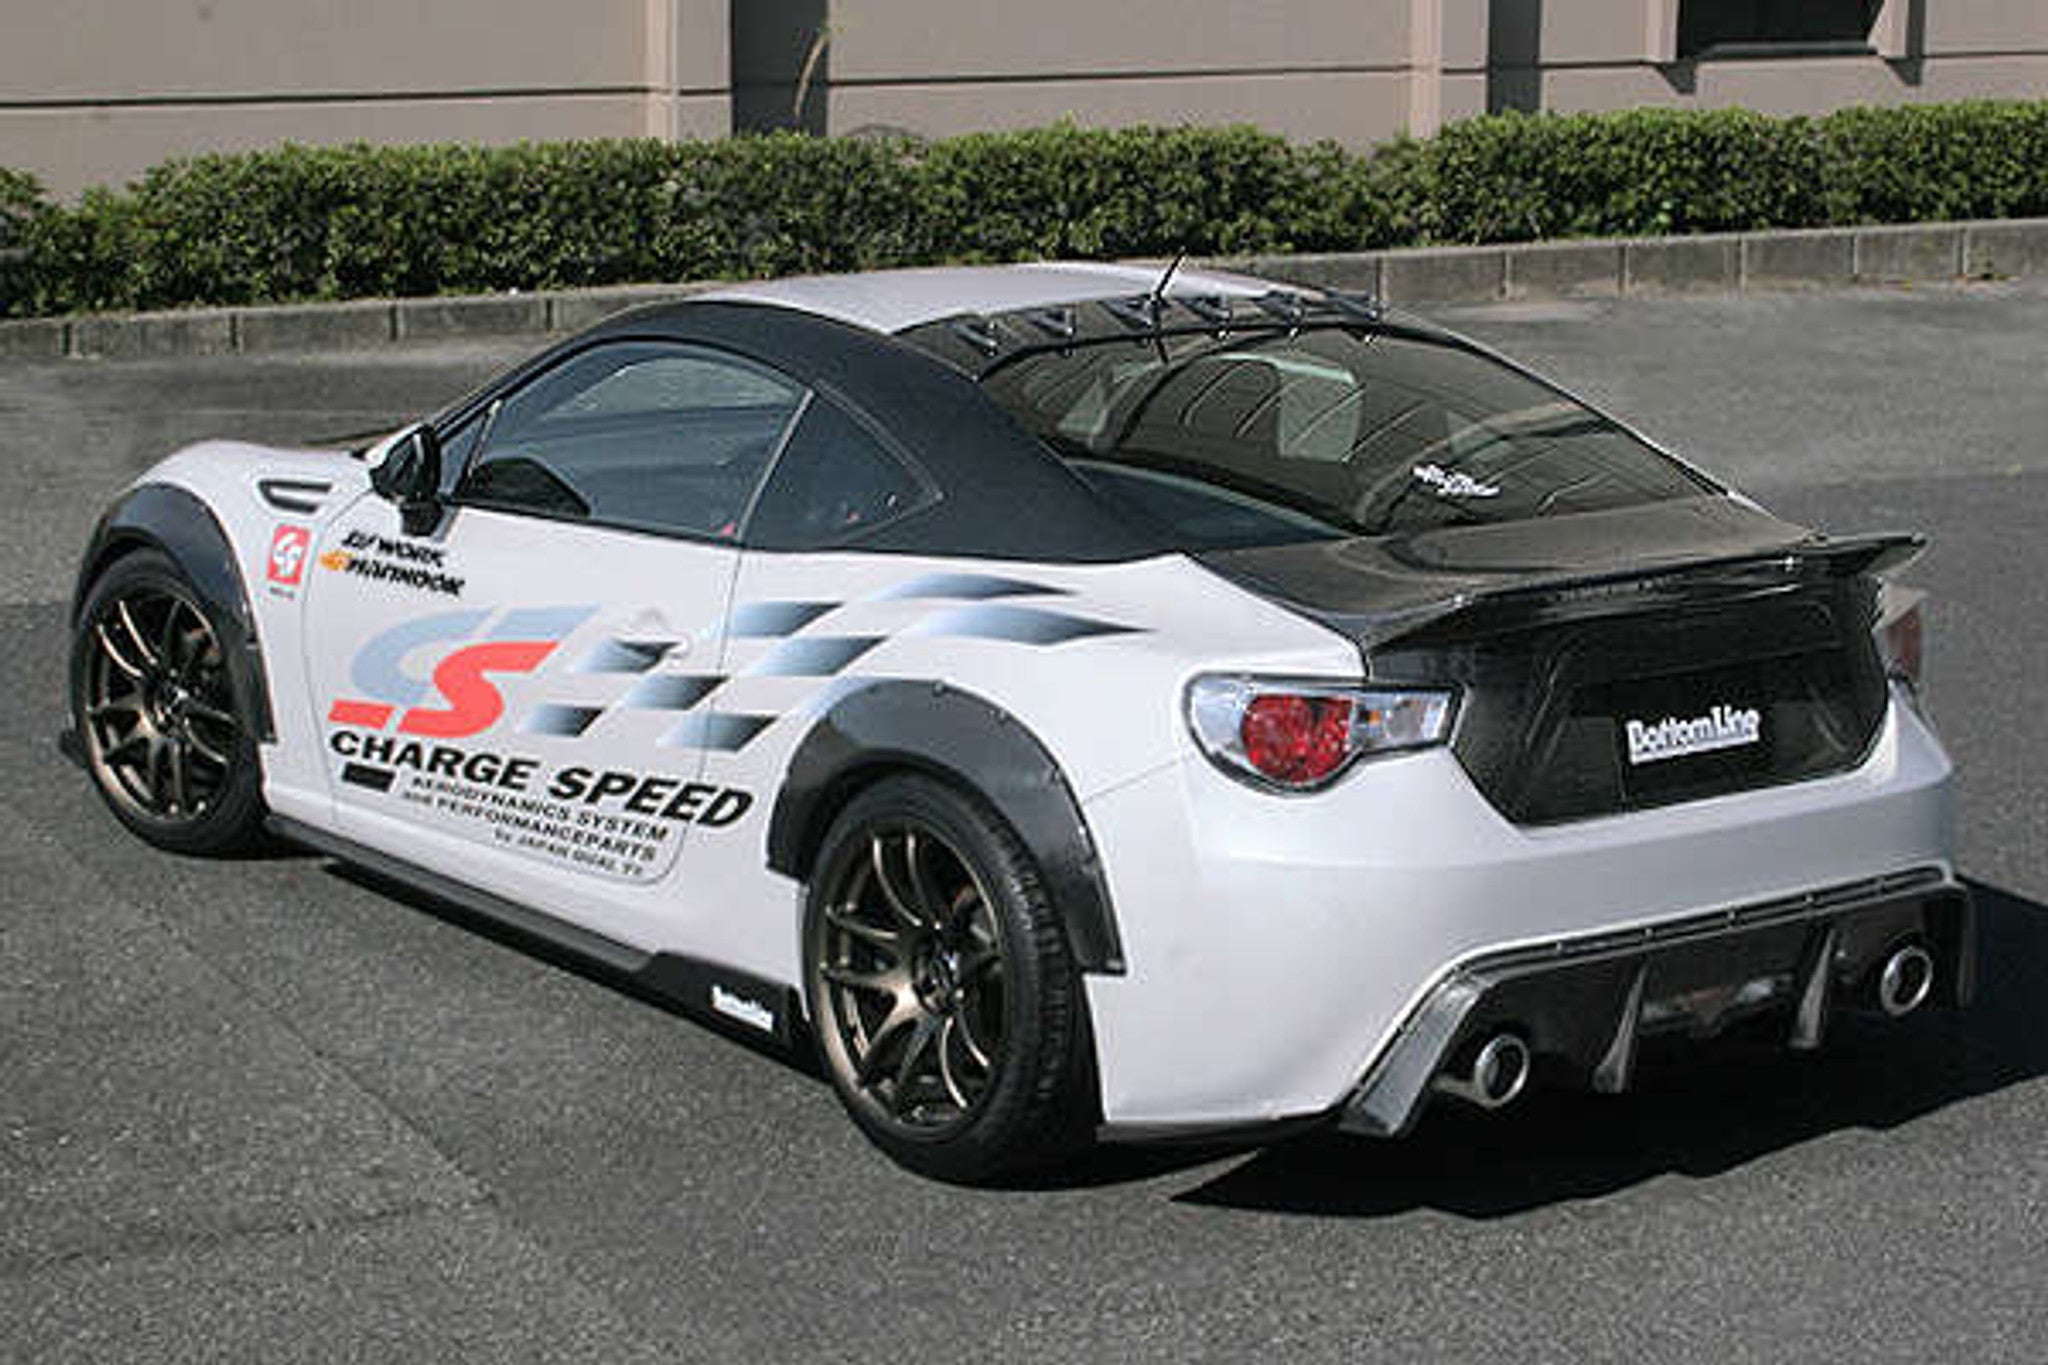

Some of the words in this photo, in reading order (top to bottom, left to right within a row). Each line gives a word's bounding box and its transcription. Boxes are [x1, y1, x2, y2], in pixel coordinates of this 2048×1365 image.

[329, 730, 540, 791] CHARGE
[548, 767, 755, 828] SPEED
[576, 809, 669, 840] SYSTEM
